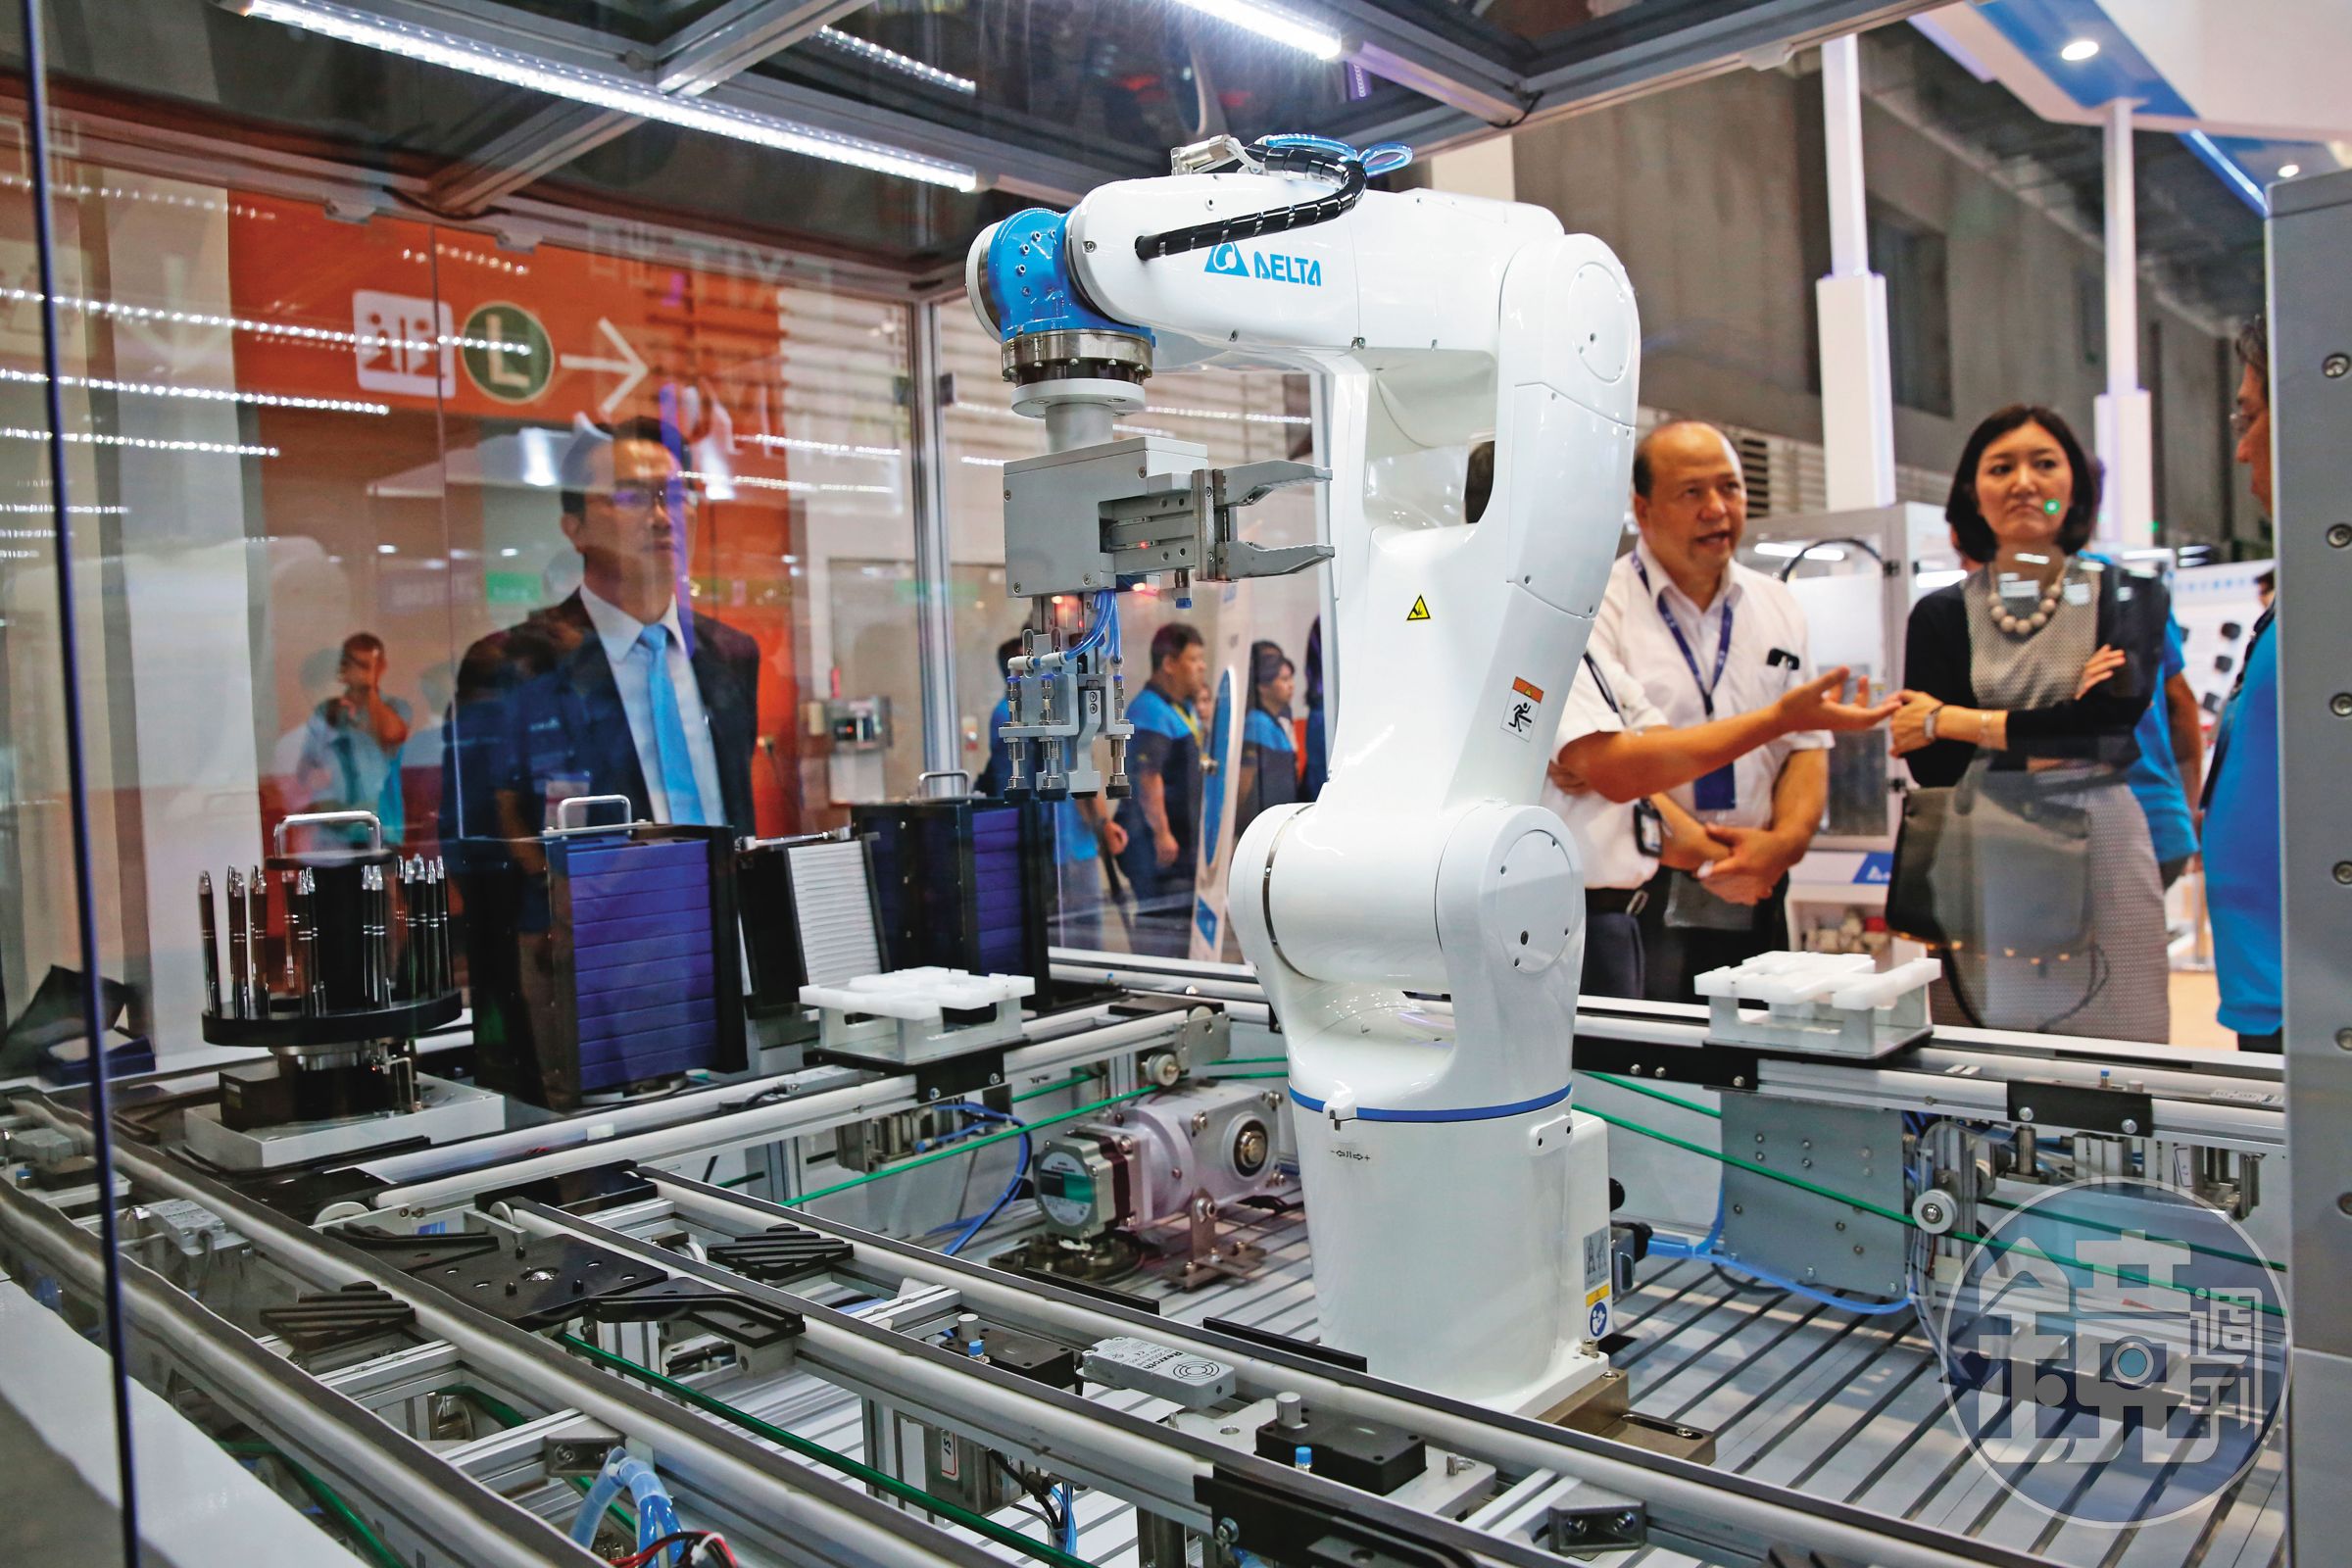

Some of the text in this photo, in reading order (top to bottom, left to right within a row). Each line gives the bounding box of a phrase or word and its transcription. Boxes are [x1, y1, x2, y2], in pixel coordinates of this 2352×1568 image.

[1253, 251, 1321, 286] DELTA
[486, 315, 530, 388] L
[1143, 1350, 1184, 1370] Rexroth
